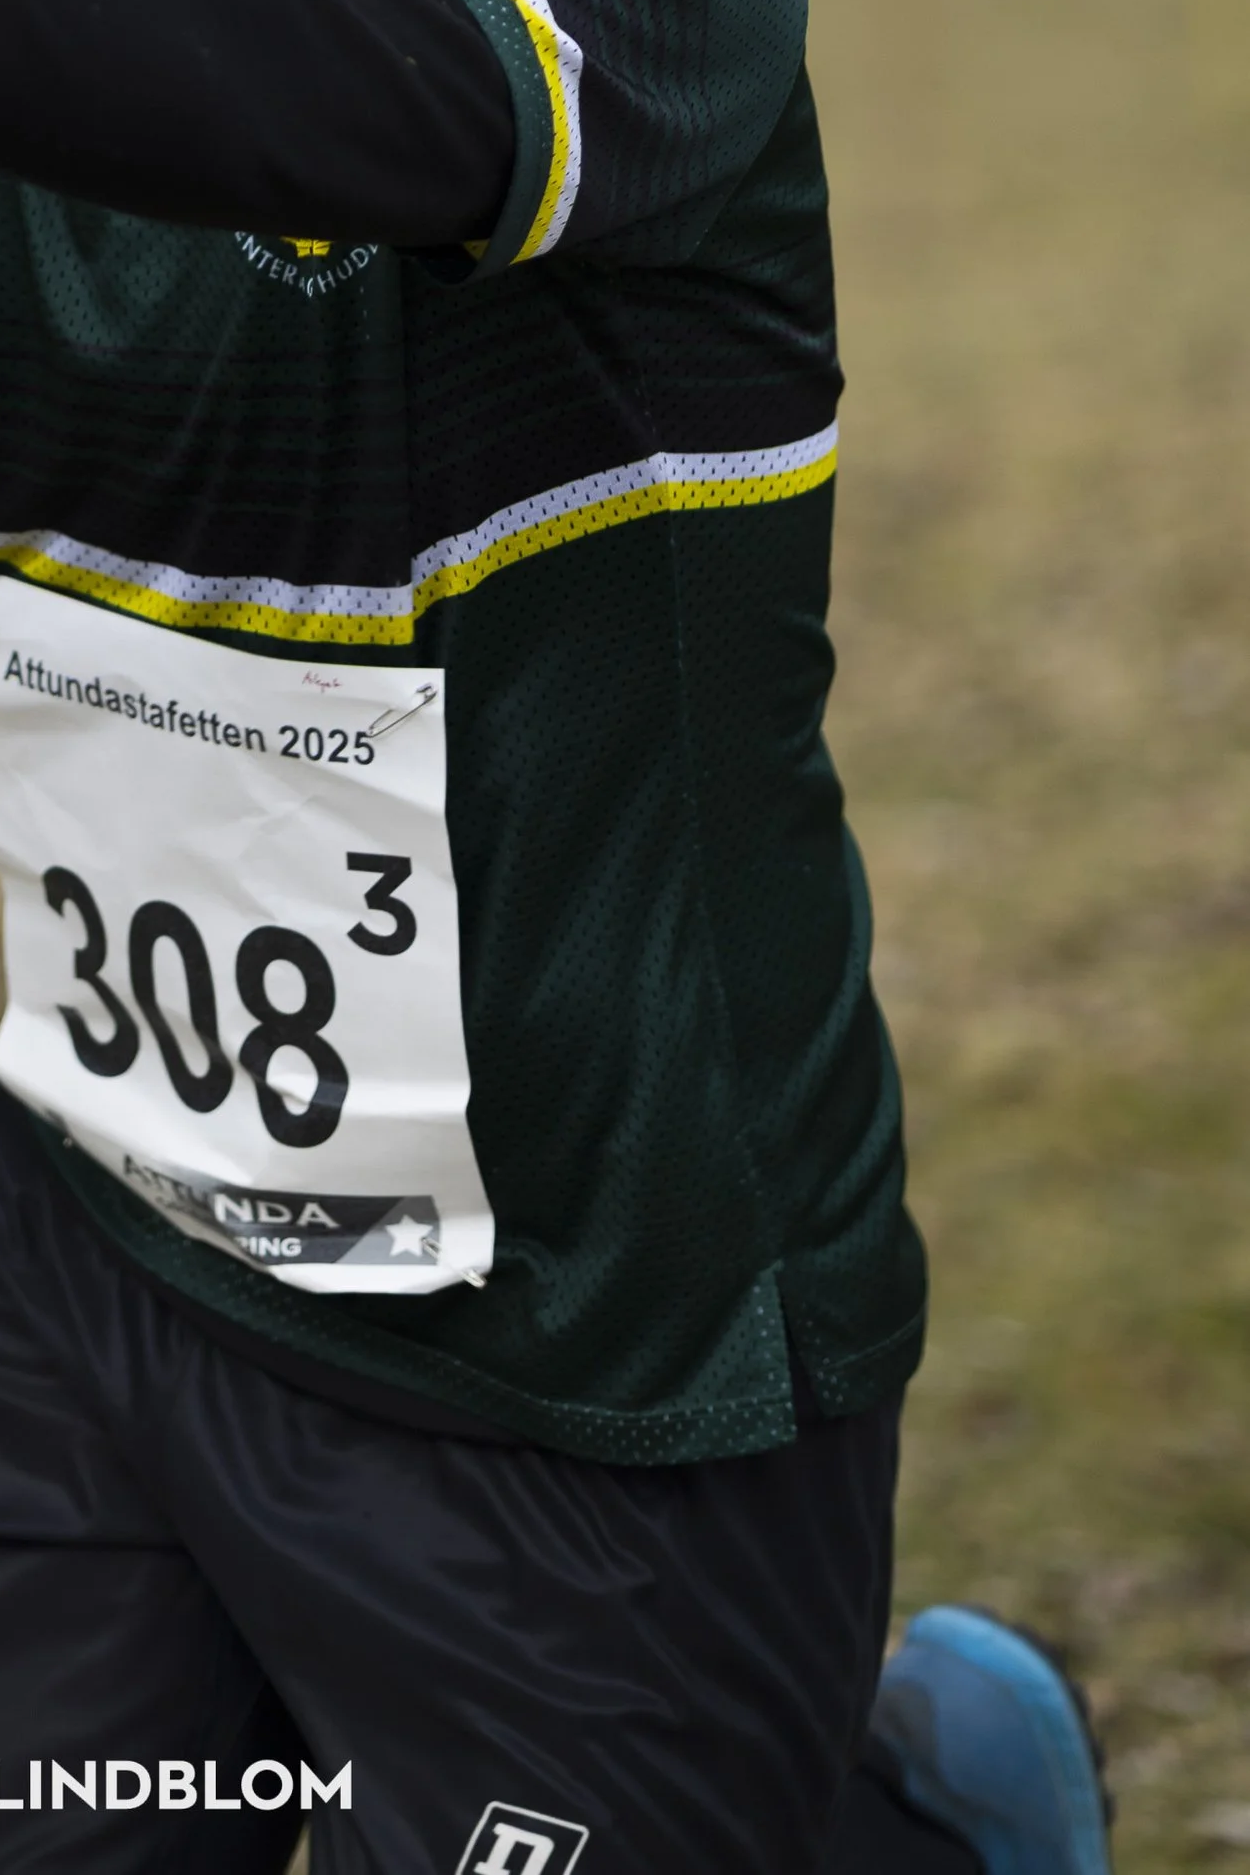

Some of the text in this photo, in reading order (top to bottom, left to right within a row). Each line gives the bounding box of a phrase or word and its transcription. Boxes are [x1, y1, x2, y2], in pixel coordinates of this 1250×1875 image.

[4, 650, 376, 765] Attundastafetten 2025
[346, 851, 418, 956] 3
[42, 865, 350, 1149] 308
